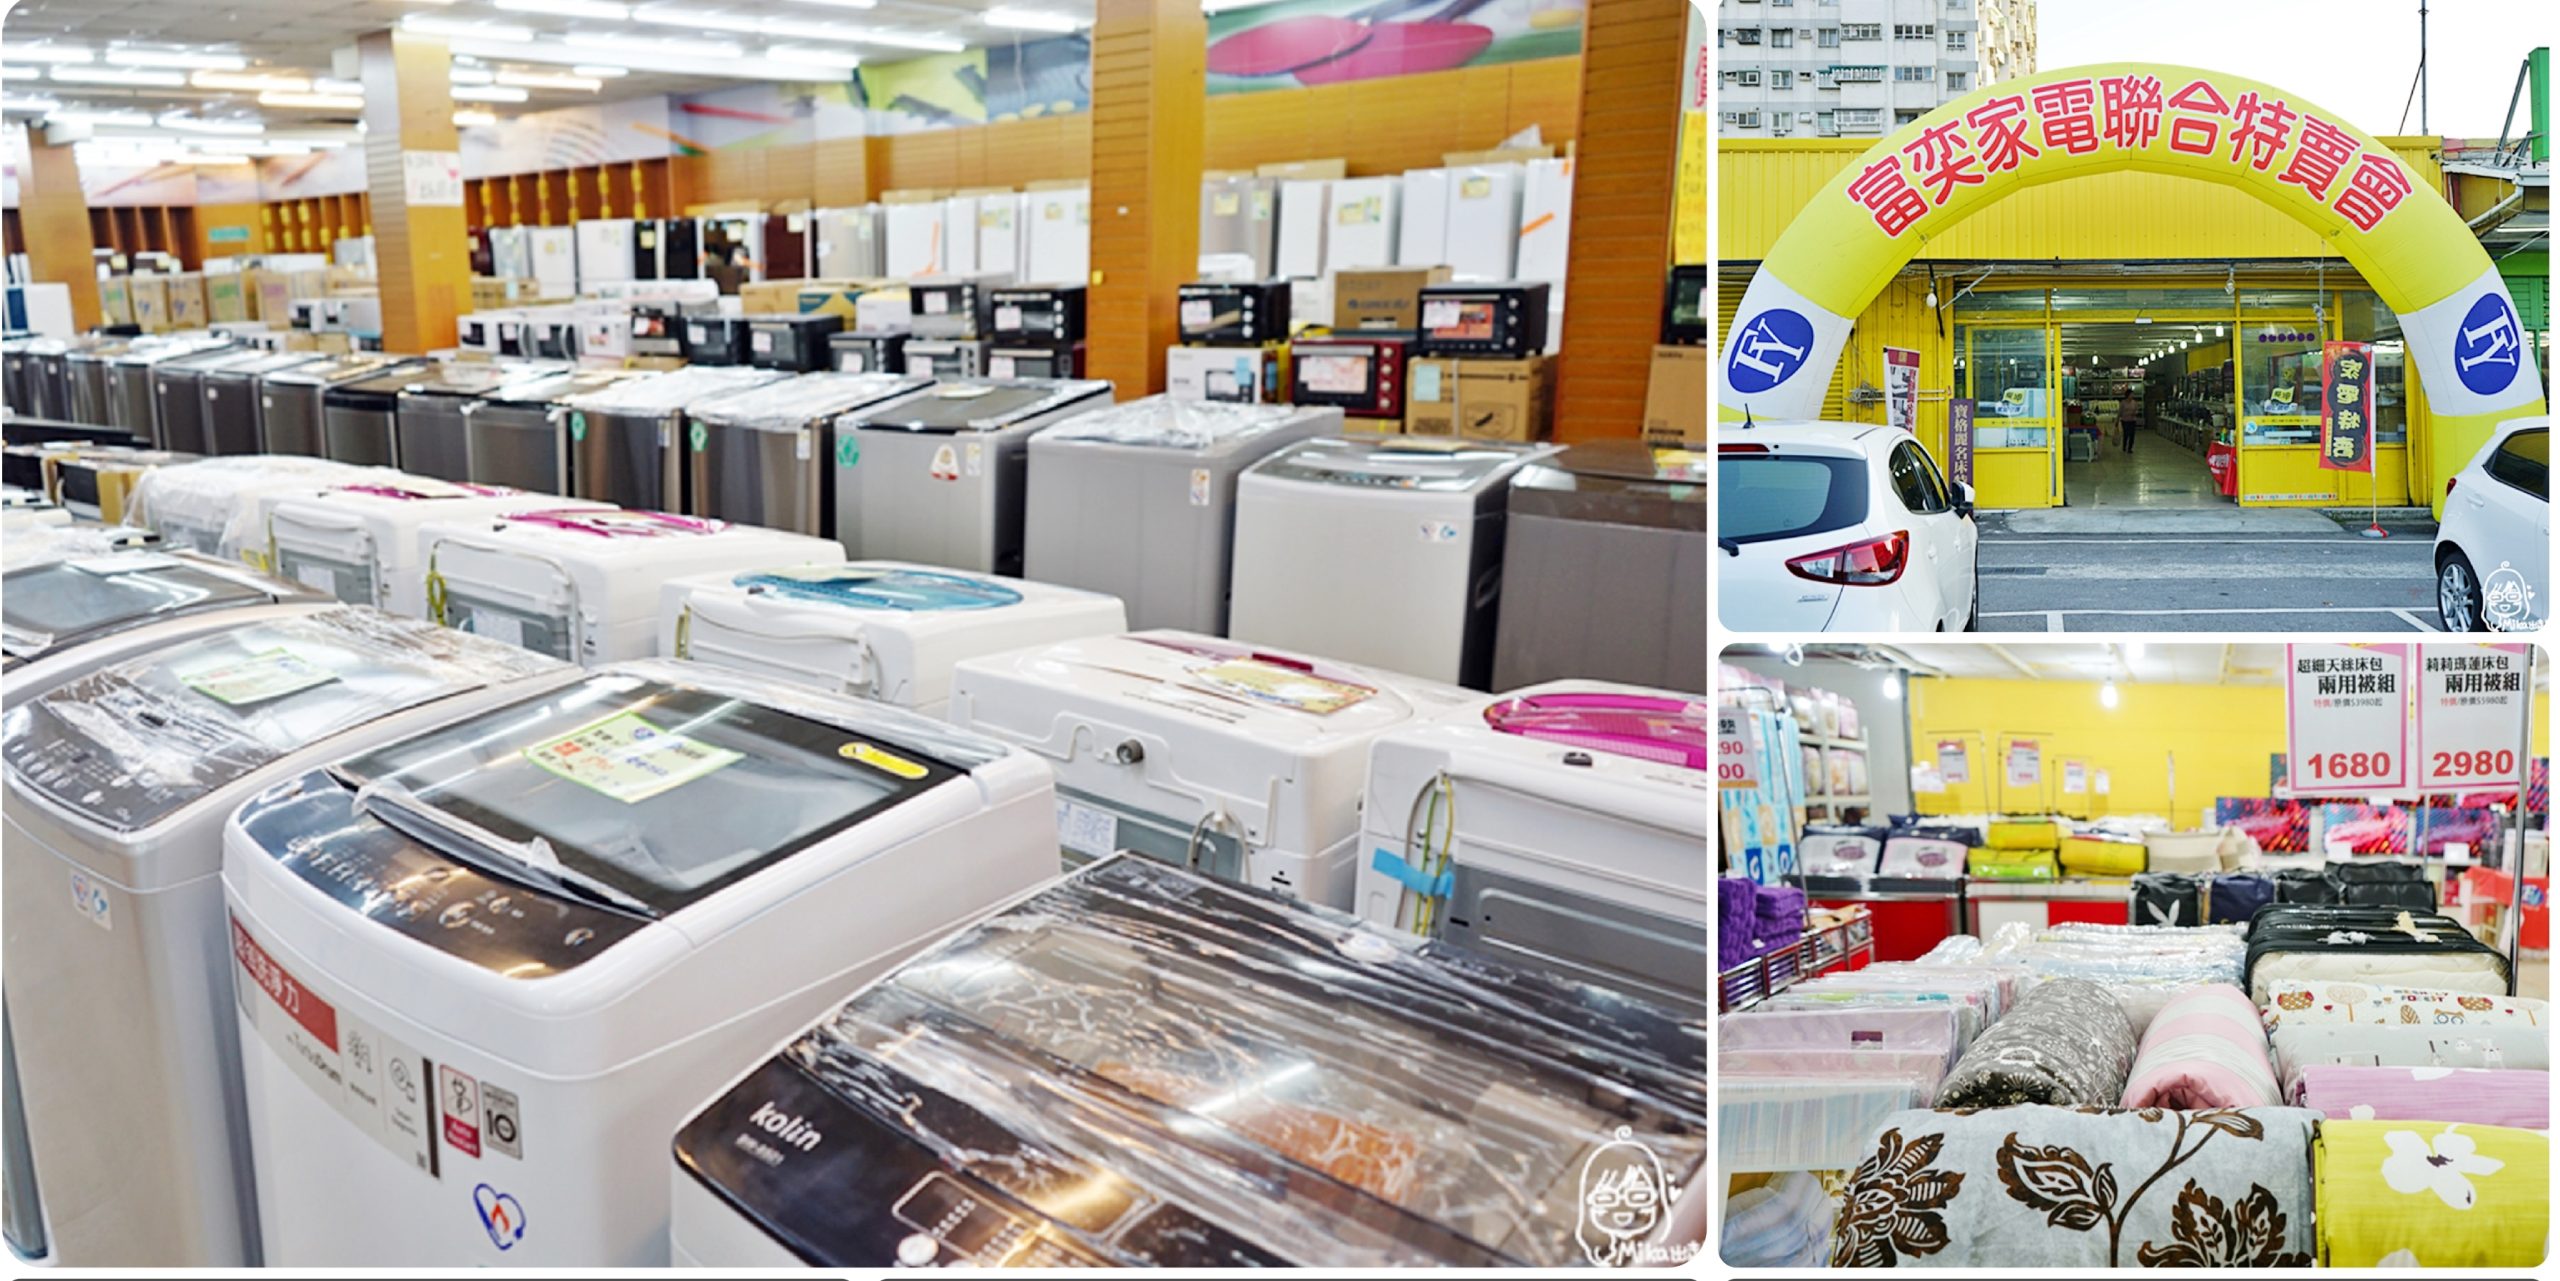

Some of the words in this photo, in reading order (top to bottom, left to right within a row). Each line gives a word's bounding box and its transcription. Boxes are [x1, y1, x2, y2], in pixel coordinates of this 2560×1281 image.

[1847, 75, 2412, 238] 富奕家電聯合特賣會
[2297, 657, 2383, 673] 超細天絲床包
[2426, 655, 2509, 671] 莉莉瑪蓮床包
[2317, 673, 2396, 695] 兩用被組
[2445, 672, 2521, 693] 兩用被組
[2307, 751, 2391, 779] 1680
[2433, 749, 2514, 777] 2980
[749, 1100, 822, 1152] kolin
